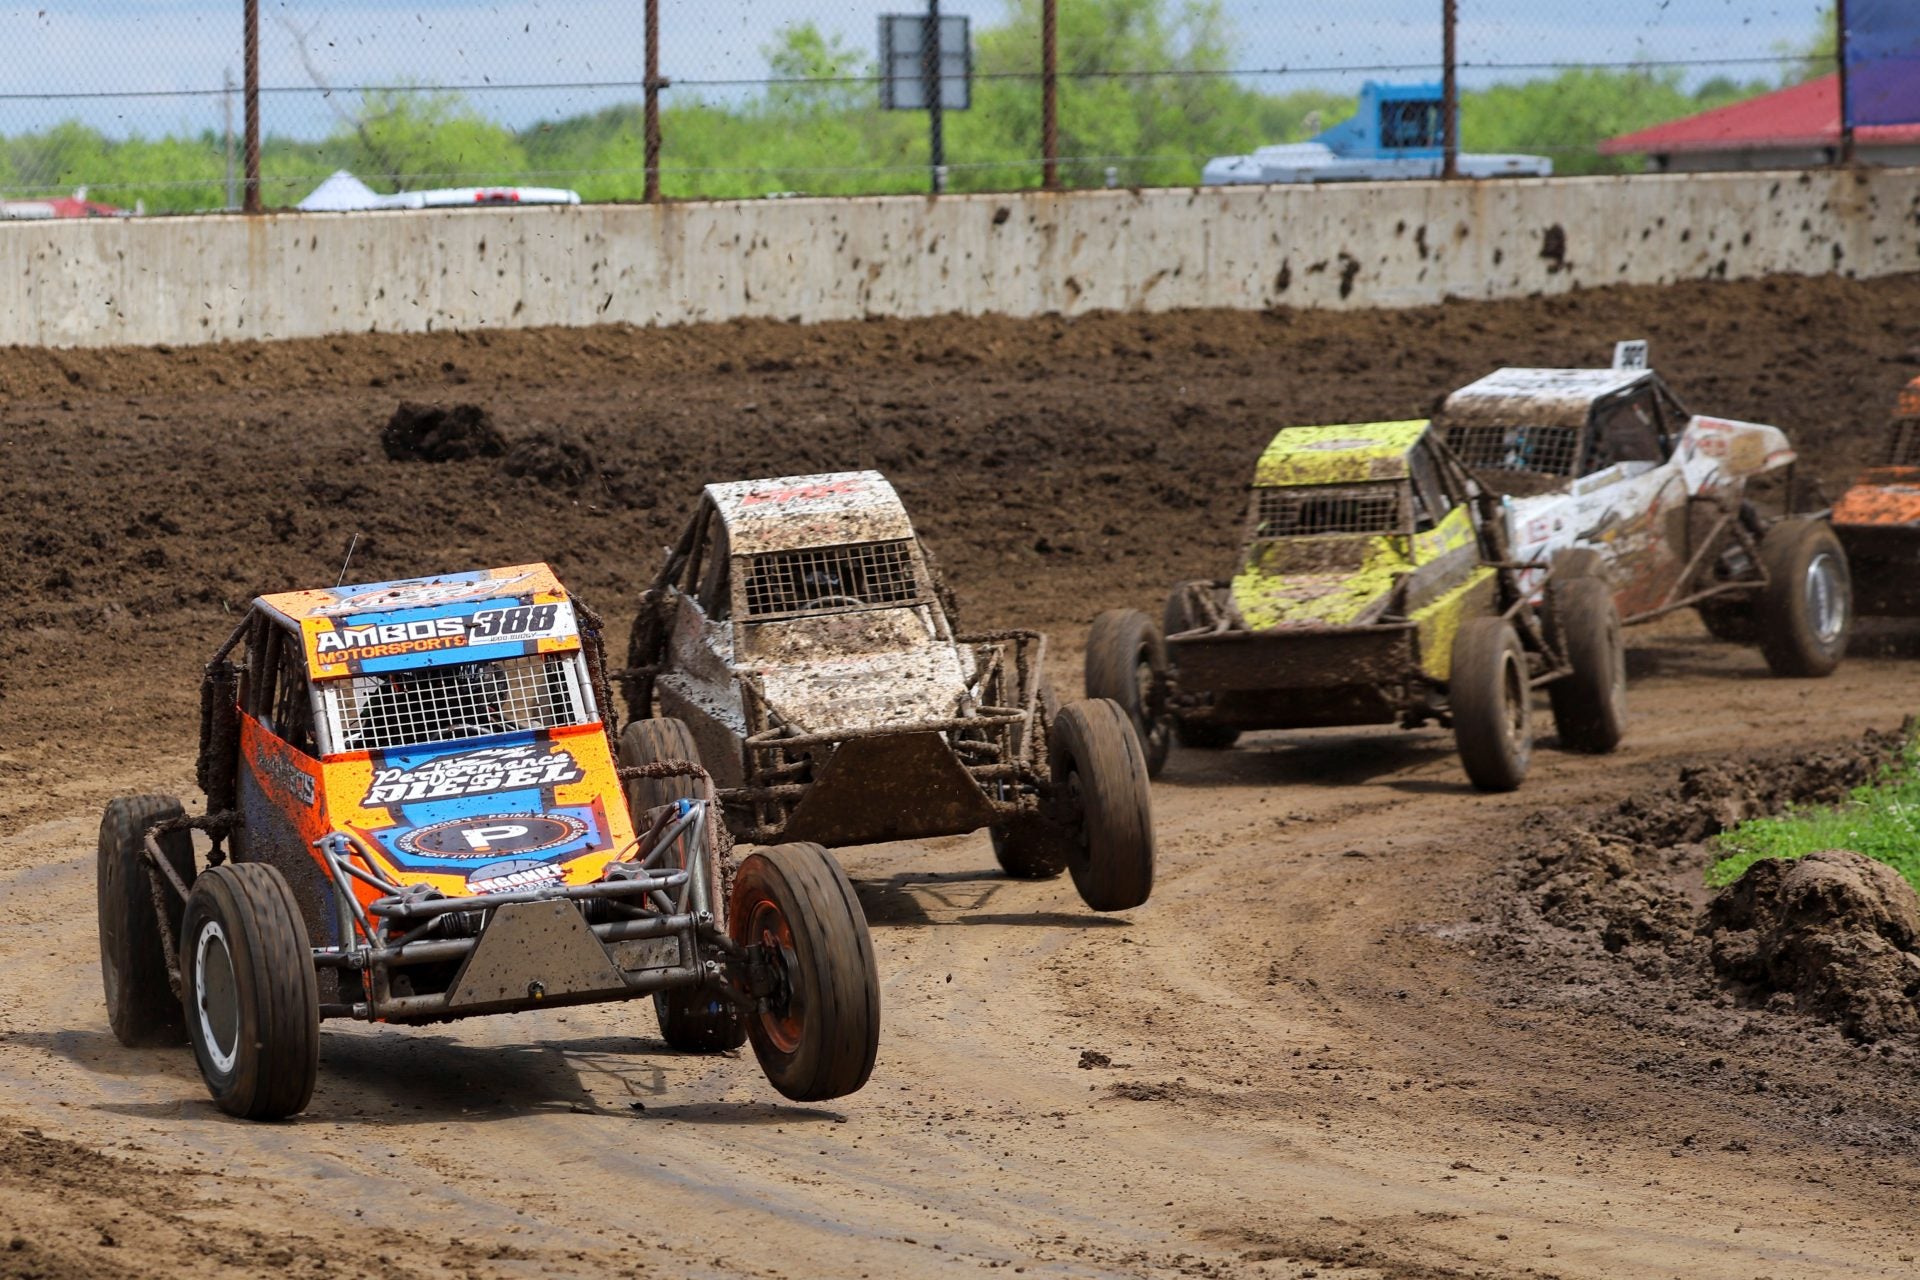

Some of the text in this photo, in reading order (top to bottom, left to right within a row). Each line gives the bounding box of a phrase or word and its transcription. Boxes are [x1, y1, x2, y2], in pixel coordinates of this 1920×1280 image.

[317, 617, 466, 652] AMBOS
[474, 605, 558, 637] 388
[318, 634, 467, 665] MOTORSPORTS
[363, 762, 577, 805] DIESEL
[375, 753, 570, 786] Performance
